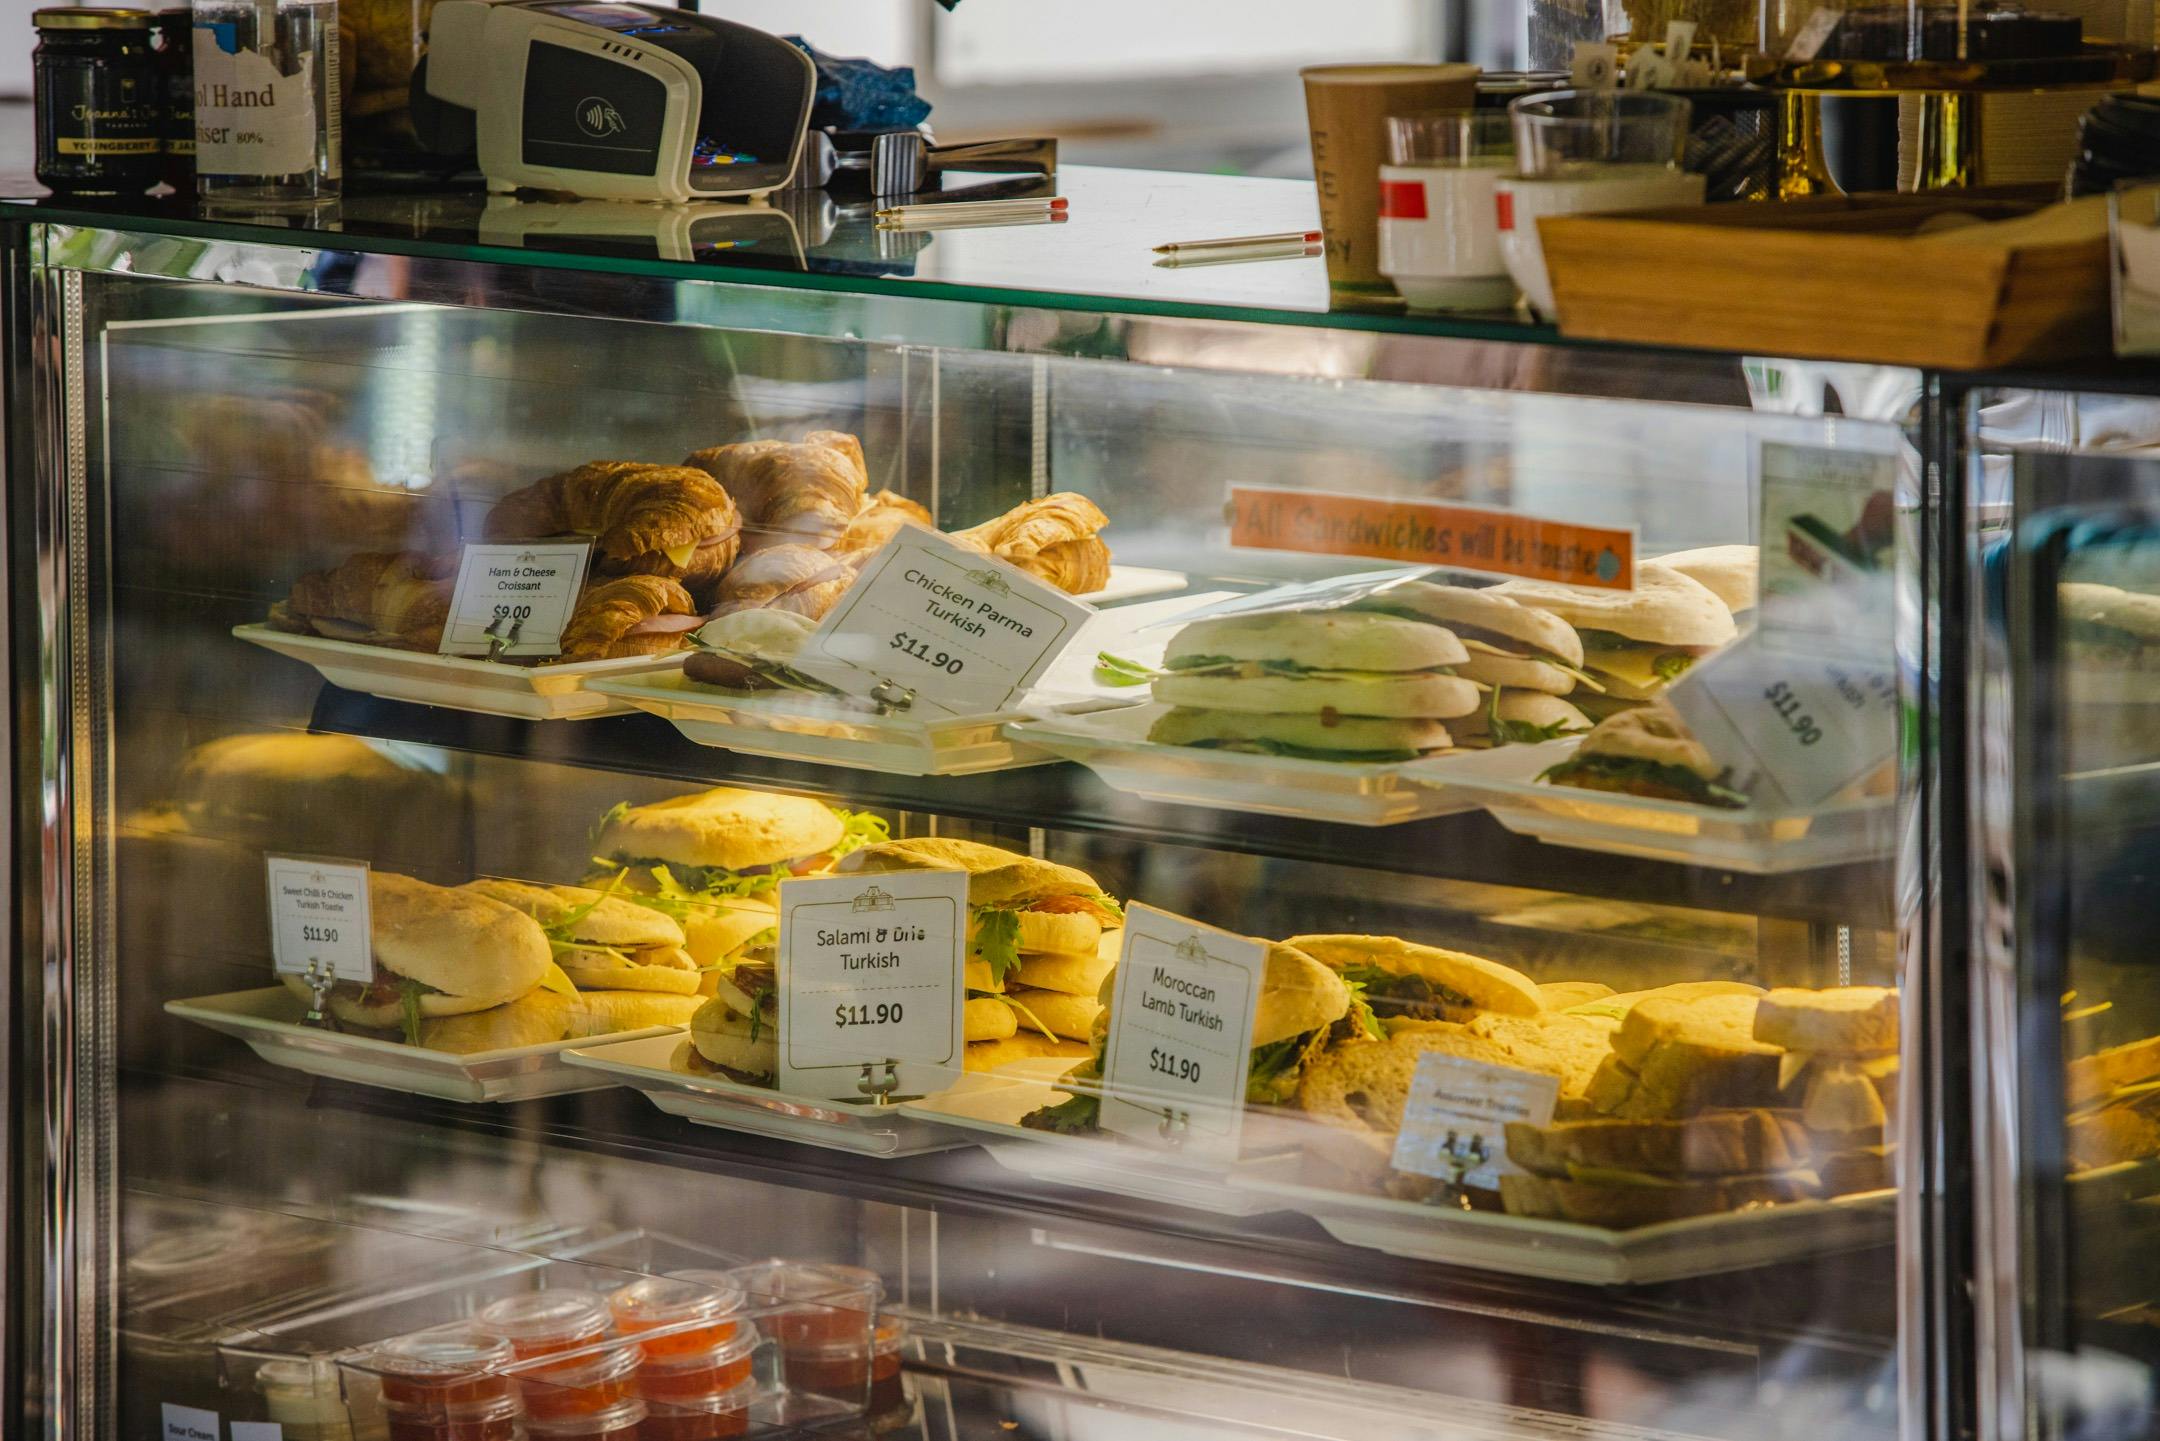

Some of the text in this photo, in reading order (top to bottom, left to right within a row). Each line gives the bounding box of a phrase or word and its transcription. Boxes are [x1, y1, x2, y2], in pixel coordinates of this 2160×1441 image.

[213, 84, 275, 107] Hand
[236, 132, 264, 145] 80%
[1295, 504, 1453, 555] Sandwiches
[488, 567, 556, 577] Ham & Cheese
[497, 581, 541, 591] Croissant
[492, 604, 531, 619] $9.00
[904, 569, 1033, 638] Chicken Parma
[925, 599, 987, 638] Turkish
[890, 632, 964, 675] $11.90
[303, 925, 339, 942] $11.90
[816, 928, 870, 947] Salami
[875, 928, 888, 943] &
[840, 952, 900, 970] Turkish
[1152, 966, 1215, 1003] Moroccan
[835, 1003, 903, 1028] $11.90
[1142, 991, 1223, 1032] Lamb Turkish
[1150, 1047, 1200, 1083] $11.90
